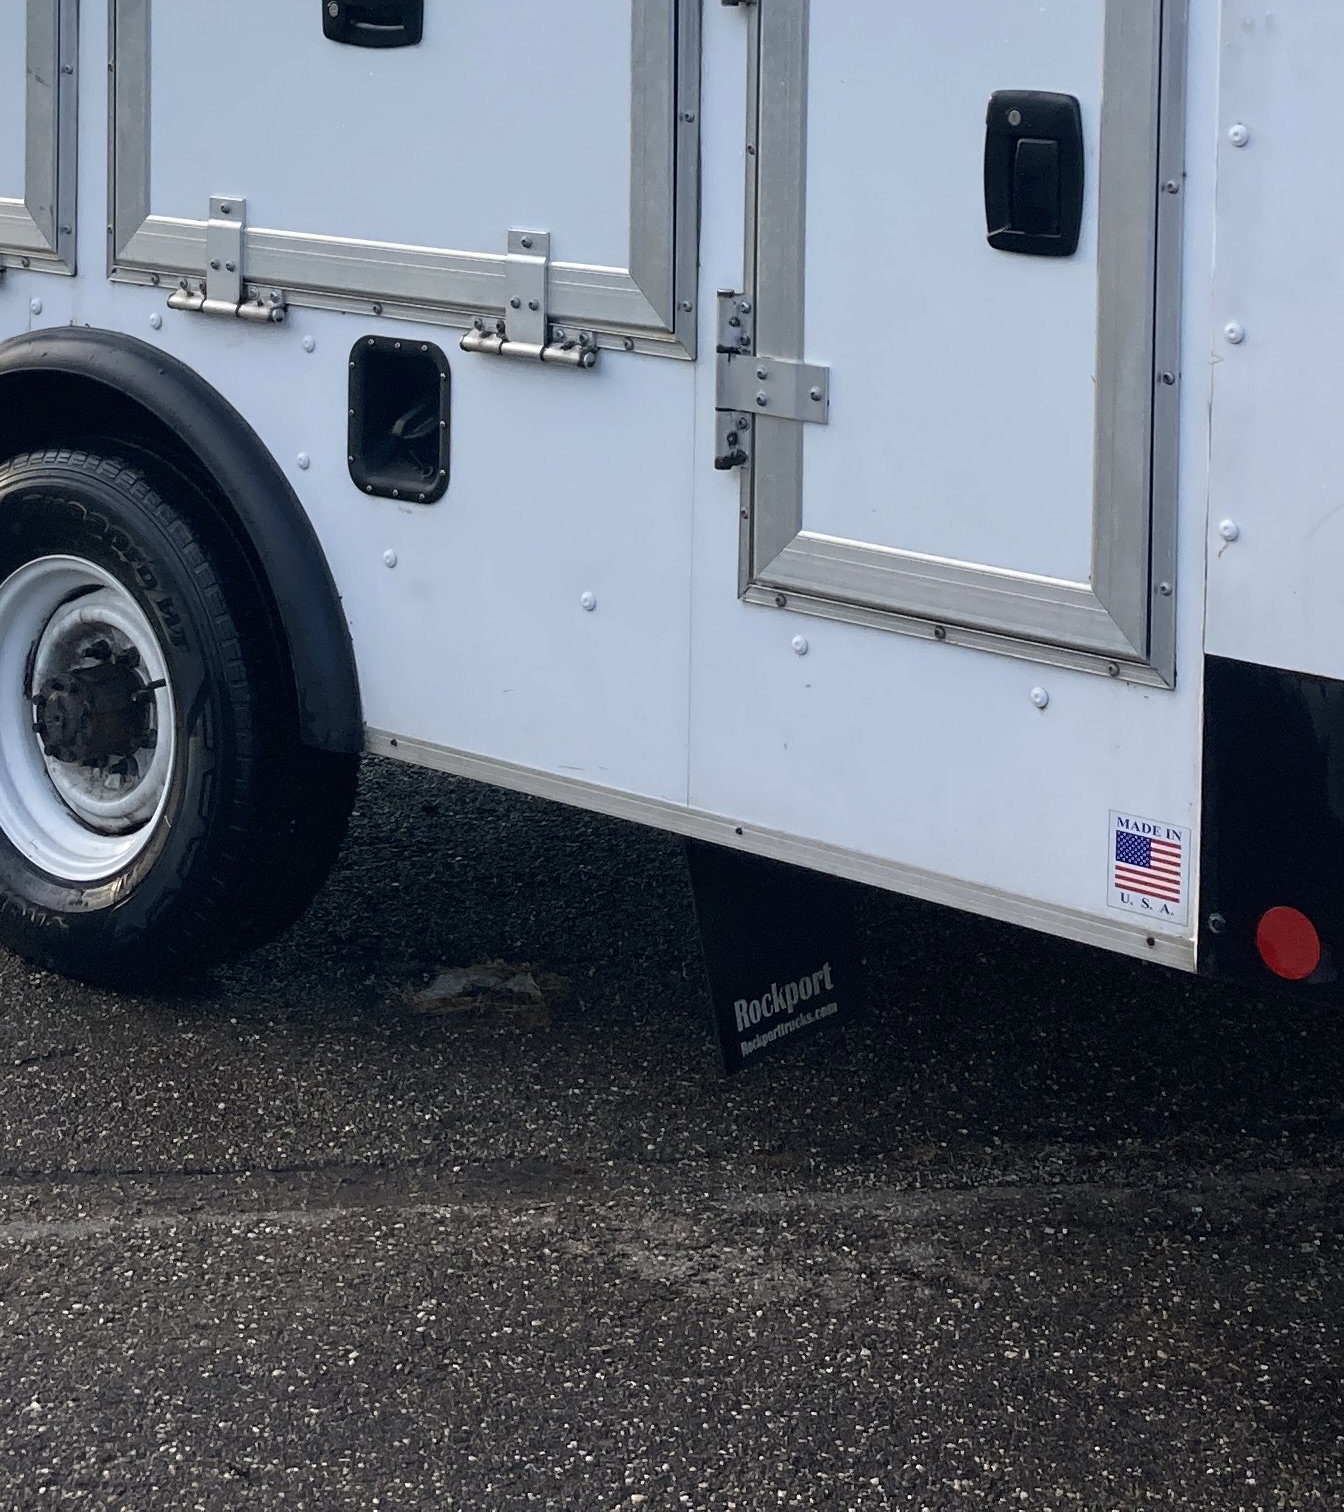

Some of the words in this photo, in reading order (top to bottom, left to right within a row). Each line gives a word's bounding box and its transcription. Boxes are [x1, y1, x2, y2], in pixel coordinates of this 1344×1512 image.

[1116, 816, 1161, 837] MADE
[1166, 828, 1182, 841] IN
[734, 962, 834, 1032] Rockport
